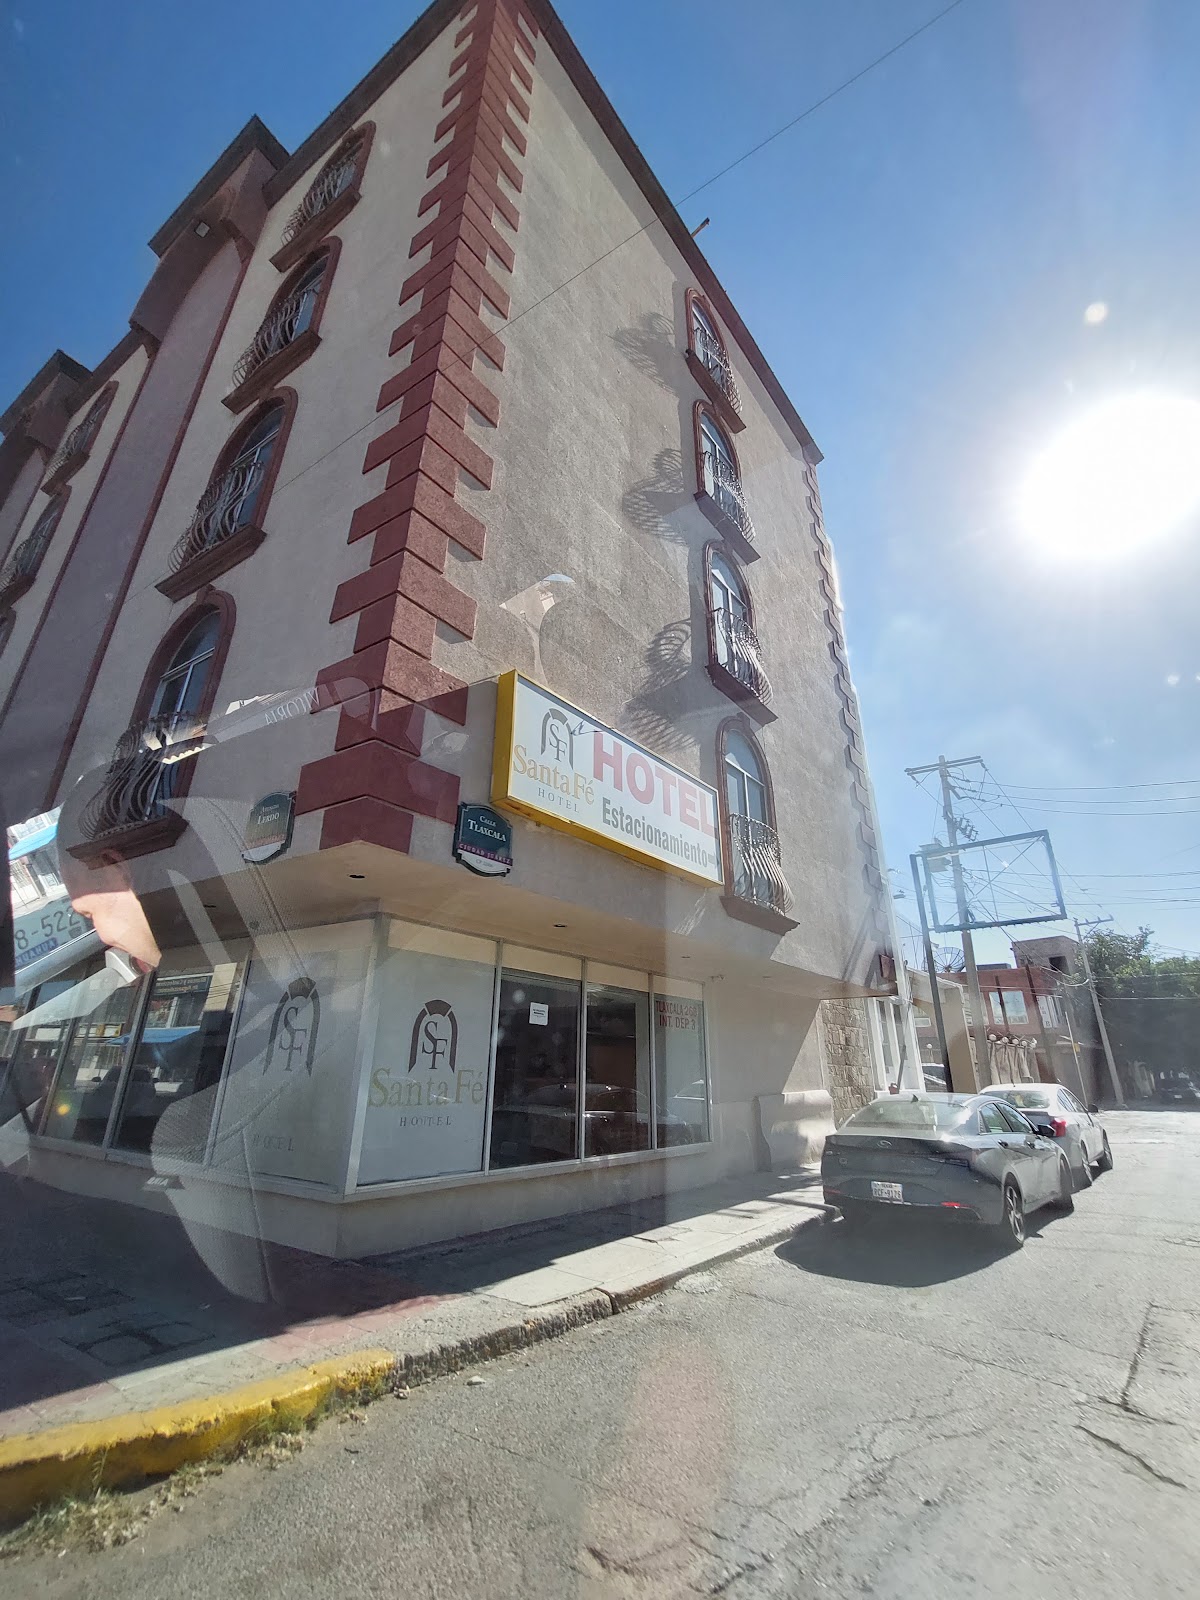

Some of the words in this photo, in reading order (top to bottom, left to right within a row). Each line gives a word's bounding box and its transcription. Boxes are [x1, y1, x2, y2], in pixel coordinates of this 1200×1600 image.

[538, 787, 580, 813] HOTEL
[593, 730, 716, 839] HOTEL
[602, 796, 708, 868] Estacionamiento
[655, 1000, 683, 1016] TLAXCALA
[368, 1067, 449, 1107] Santa
[452, 1069, 484, 1105] Fé
